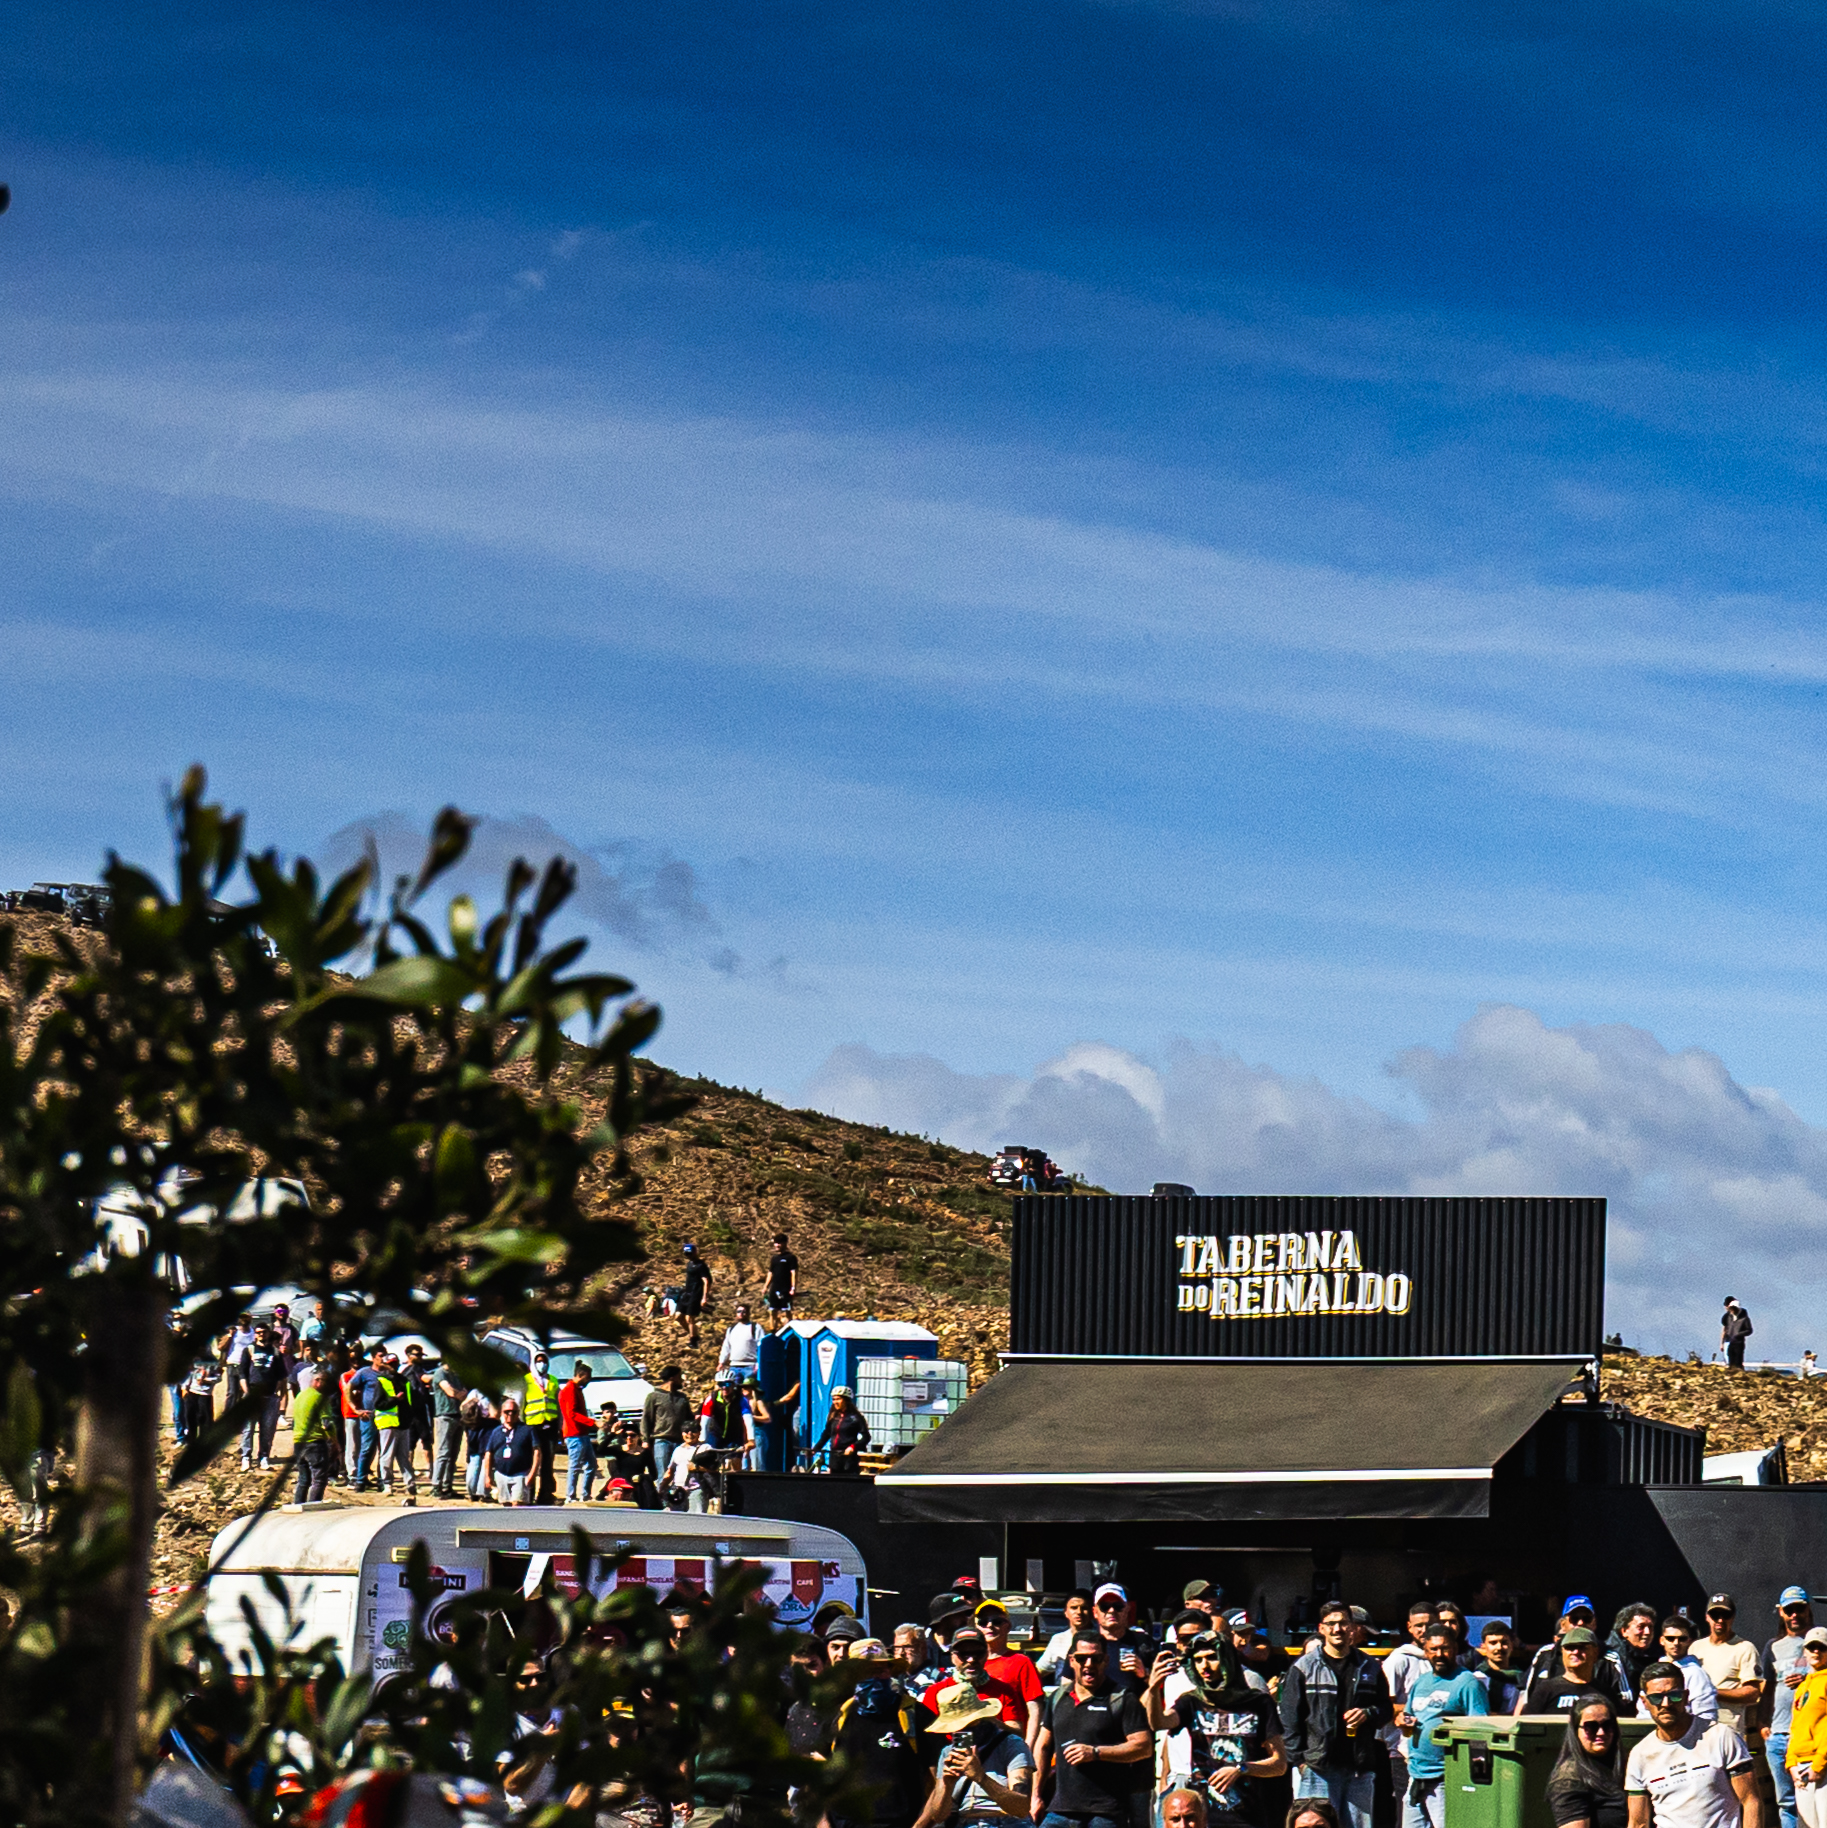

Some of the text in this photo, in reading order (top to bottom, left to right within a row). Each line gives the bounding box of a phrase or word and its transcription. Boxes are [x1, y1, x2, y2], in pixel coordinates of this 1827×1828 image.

[1175, 1230, 1362, 1276] TABERNA
[1177, 1272, 1412, 1319] DO REINALDO
